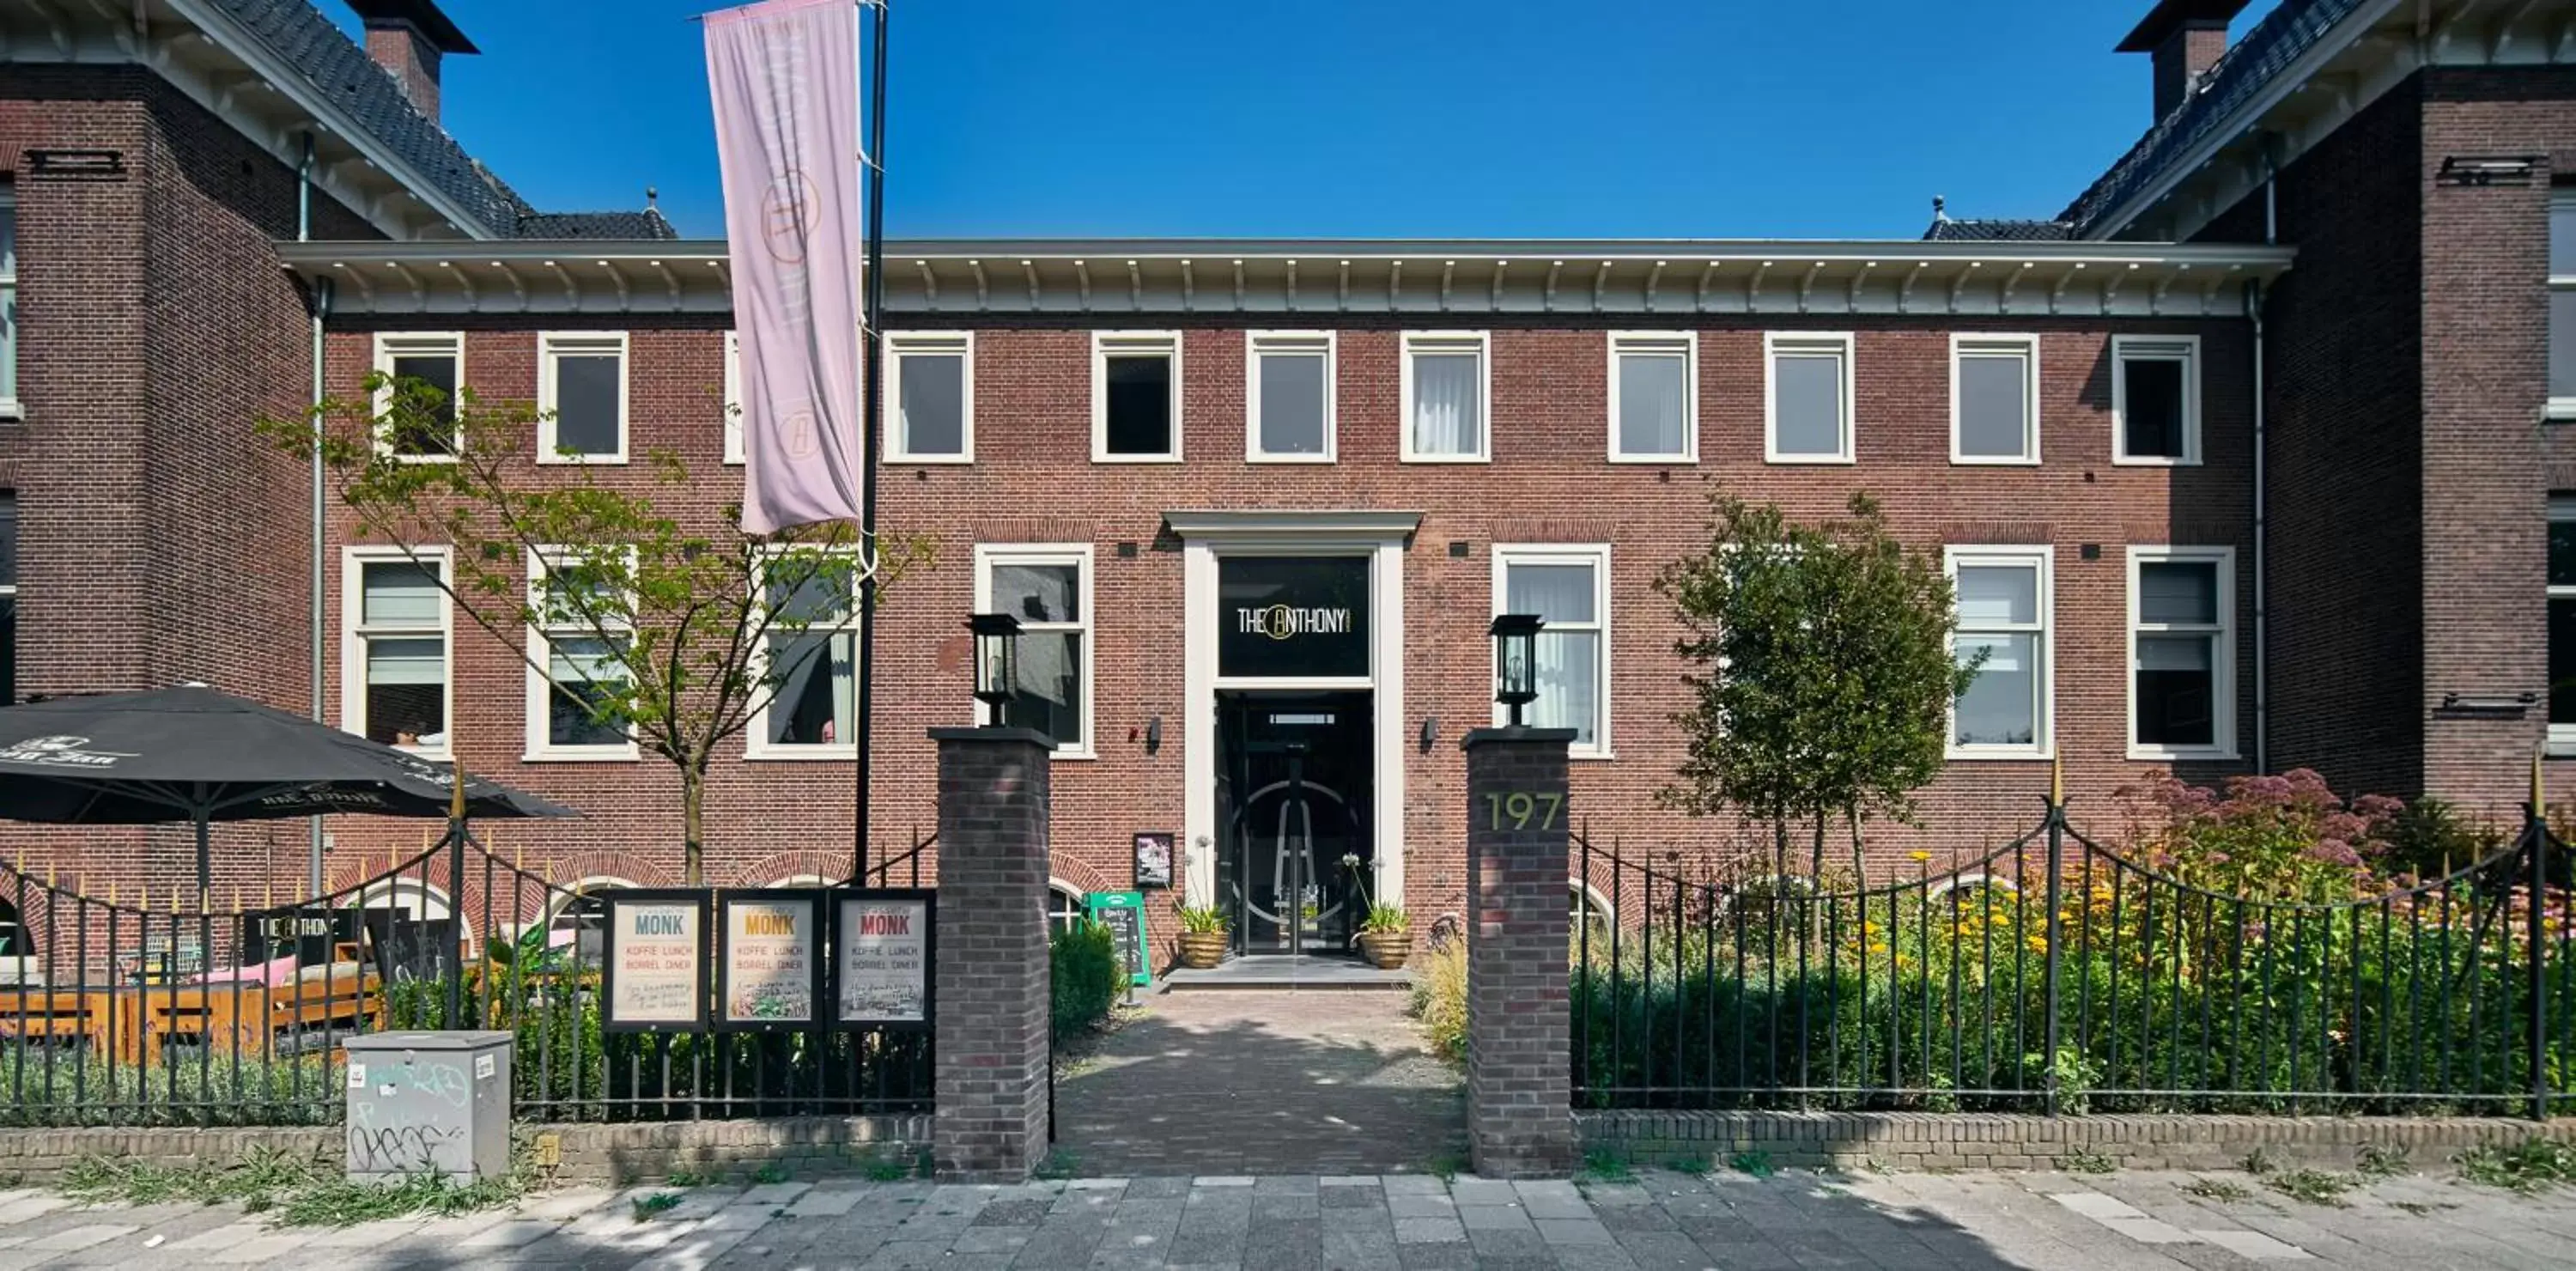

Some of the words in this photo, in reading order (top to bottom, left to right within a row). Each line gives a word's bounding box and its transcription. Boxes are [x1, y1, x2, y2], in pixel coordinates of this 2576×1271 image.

[1237, 608, 1267, 633] THE
[1274, 607, 1346, 636] ANTHONY
[1485, 792, 1562, 830] 197
[635, 915, 683, 935] MONK
[745, 915, 795, 935] MONK
[860, 915, 910, 935] MONK
[662, 946, 693, 956] LUNCH
[774, 946, 804, 956] LUNCH
[888, 946, 919, 956] LUNCH
